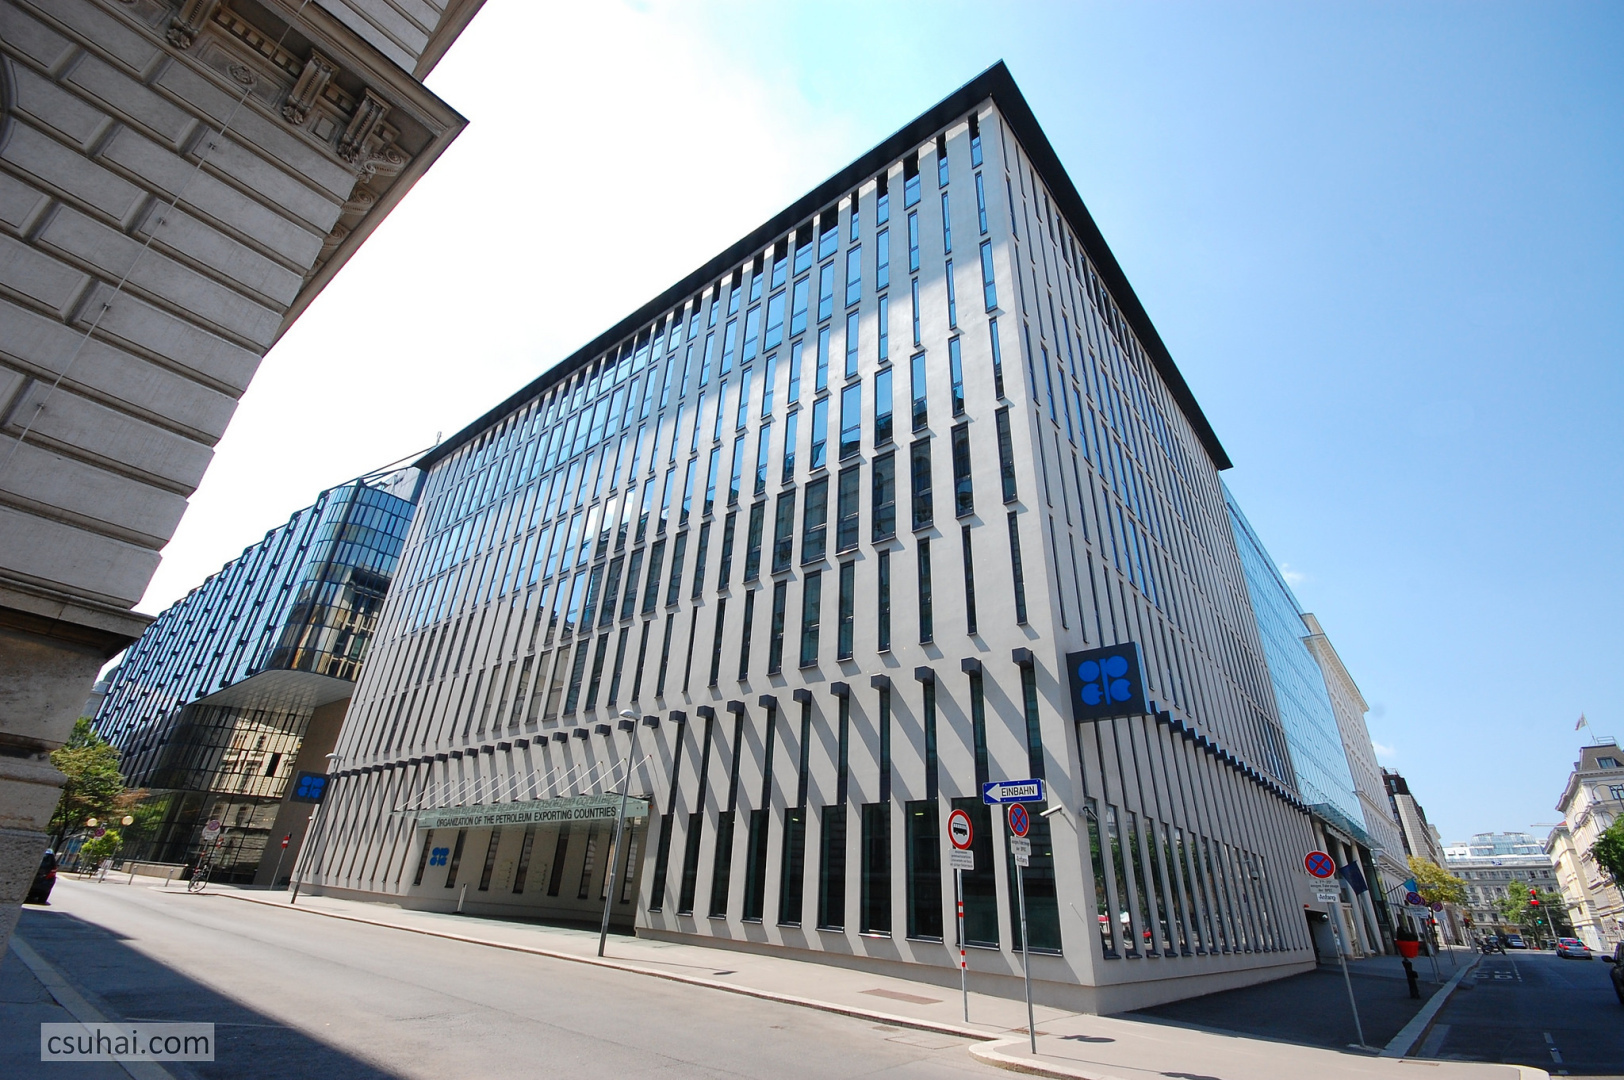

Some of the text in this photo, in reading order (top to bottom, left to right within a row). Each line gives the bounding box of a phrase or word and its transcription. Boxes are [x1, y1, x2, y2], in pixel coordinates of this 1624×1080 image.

[1001, 785, 1035, 797] EINBAHN
[436, 806, 617, 828] ORGANIZATION OF THE PETROLEUM EXPORTING COUNTRIES
